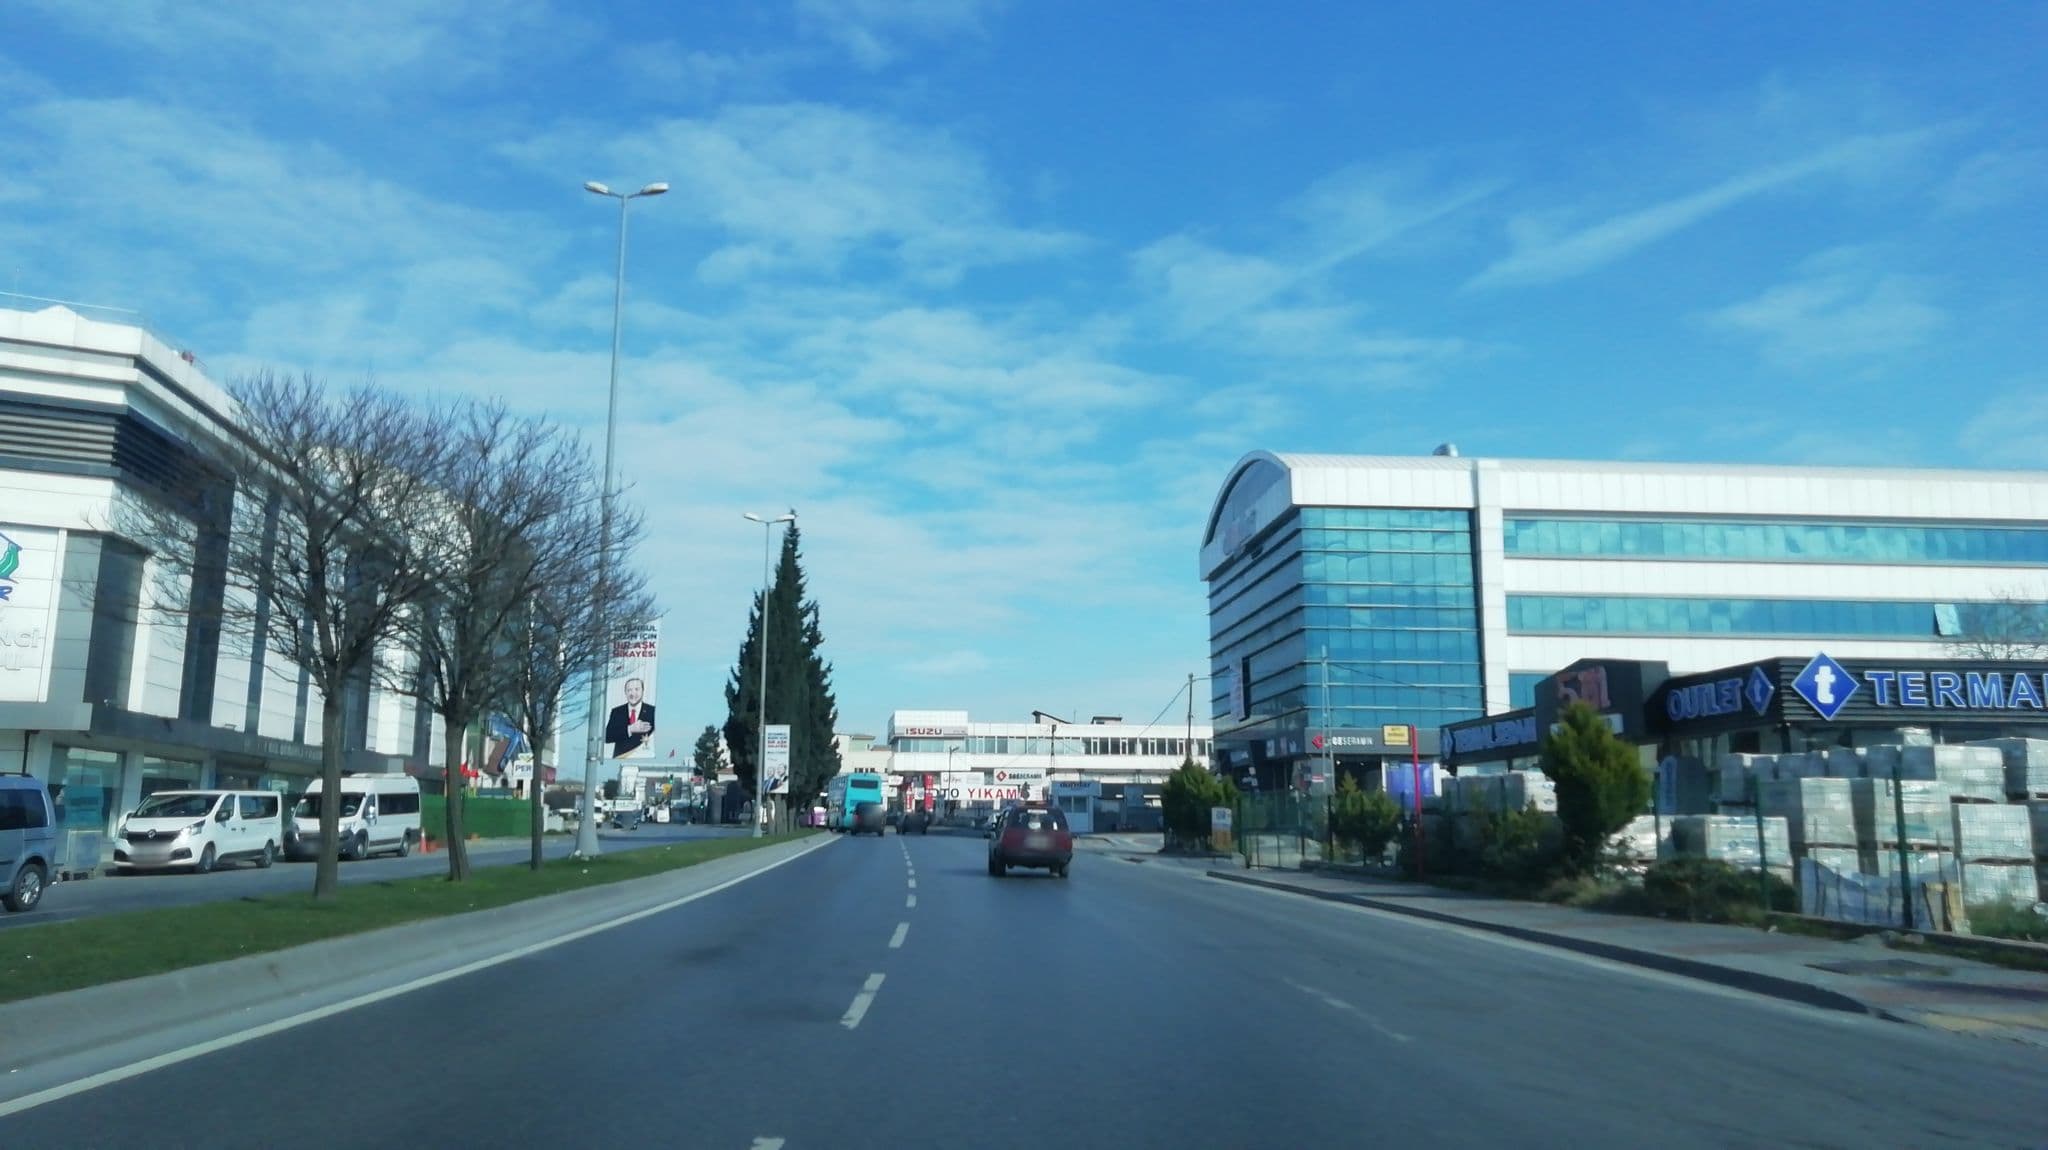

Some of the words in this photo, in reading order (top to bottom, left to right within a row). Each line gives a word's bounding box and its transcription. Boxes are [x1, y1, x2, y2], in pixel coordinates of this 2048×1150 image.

[1666, 678, 1743, 721] OUTLET
[1864, 670, 2048, 709] TERMA
[905, 727, 943, 736] ISUZU
[967, 788, 1021, 799] YIKAM
